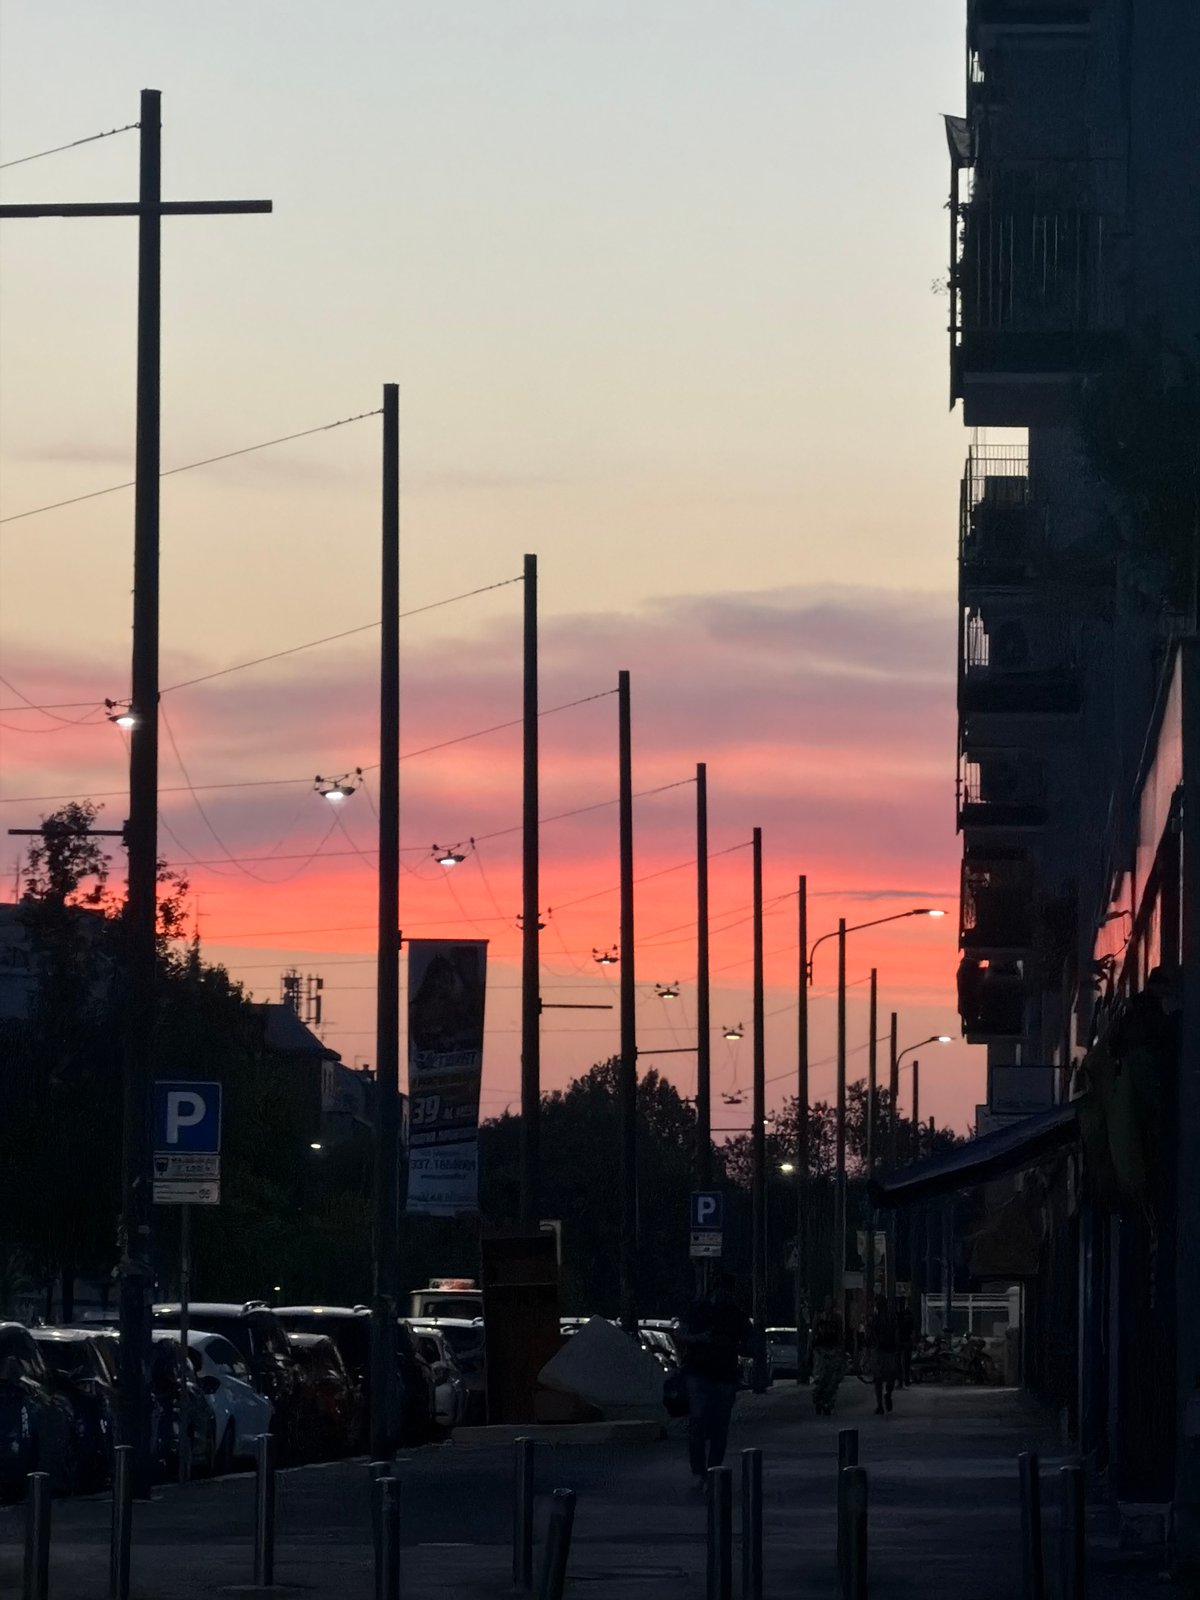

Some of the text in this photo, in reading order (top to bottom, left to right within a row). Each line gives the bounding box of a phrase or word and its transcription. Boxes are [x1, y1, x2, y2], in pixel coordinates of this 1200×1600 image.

[166, 1091, 207, 1144] P
[412, 1094, 440, 1124] 39
[698, 1196, 716, 1223] P
